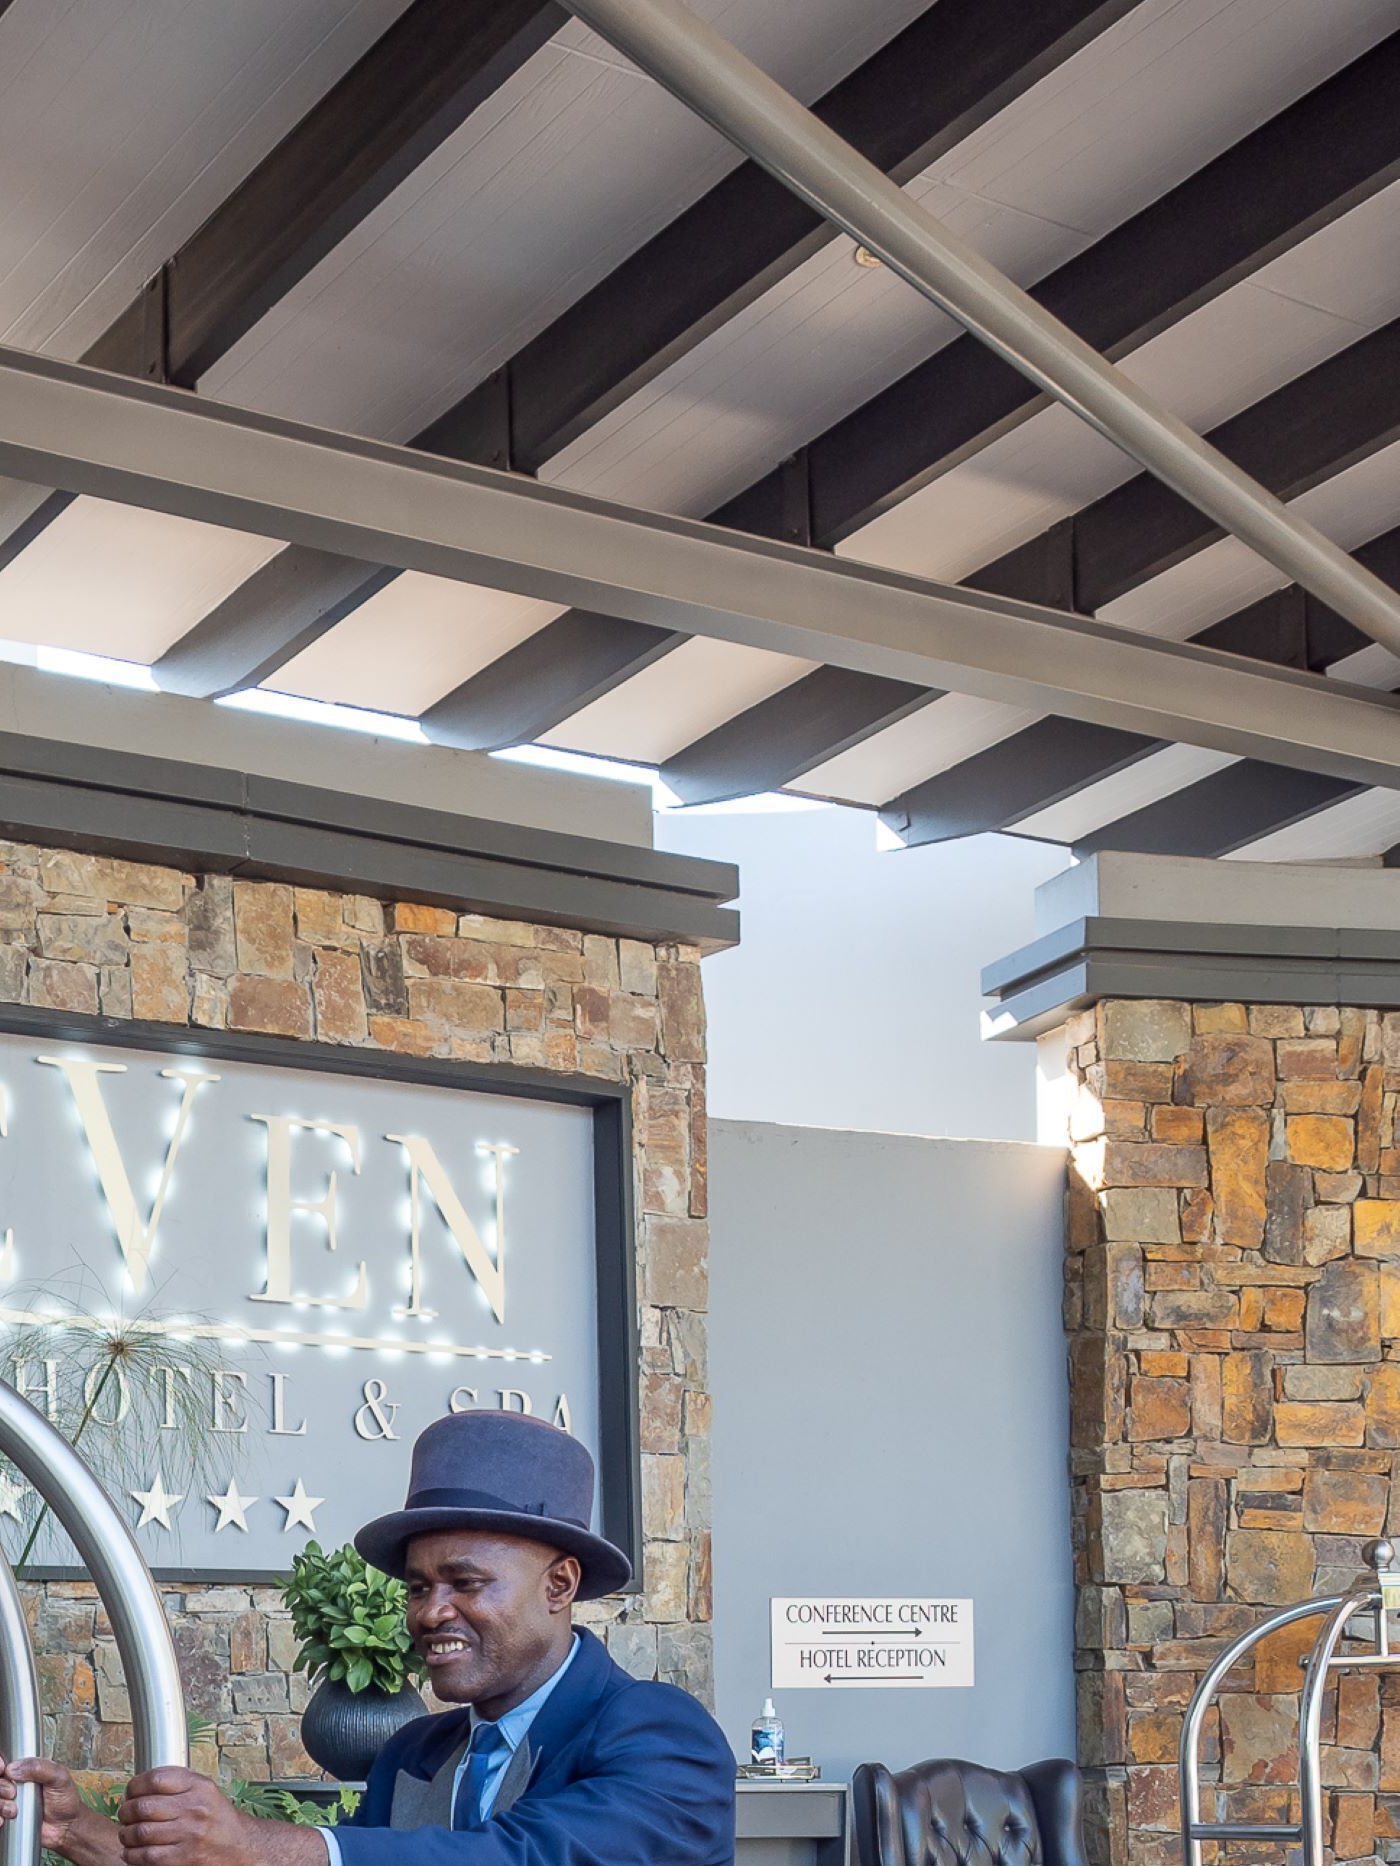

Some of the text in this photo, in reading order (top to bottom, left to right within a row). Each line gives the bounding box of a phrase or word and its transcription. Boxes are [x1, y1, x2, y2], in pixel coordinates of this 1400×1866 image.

[11, 1356, 307, 1436] HOTEL
[354, 1378, 401, 1440] &
[785, 1604, 958, 1624] CONFERENCE CENTRE
[800, 1648, 946, 1668] HOTEL RECEPTION
